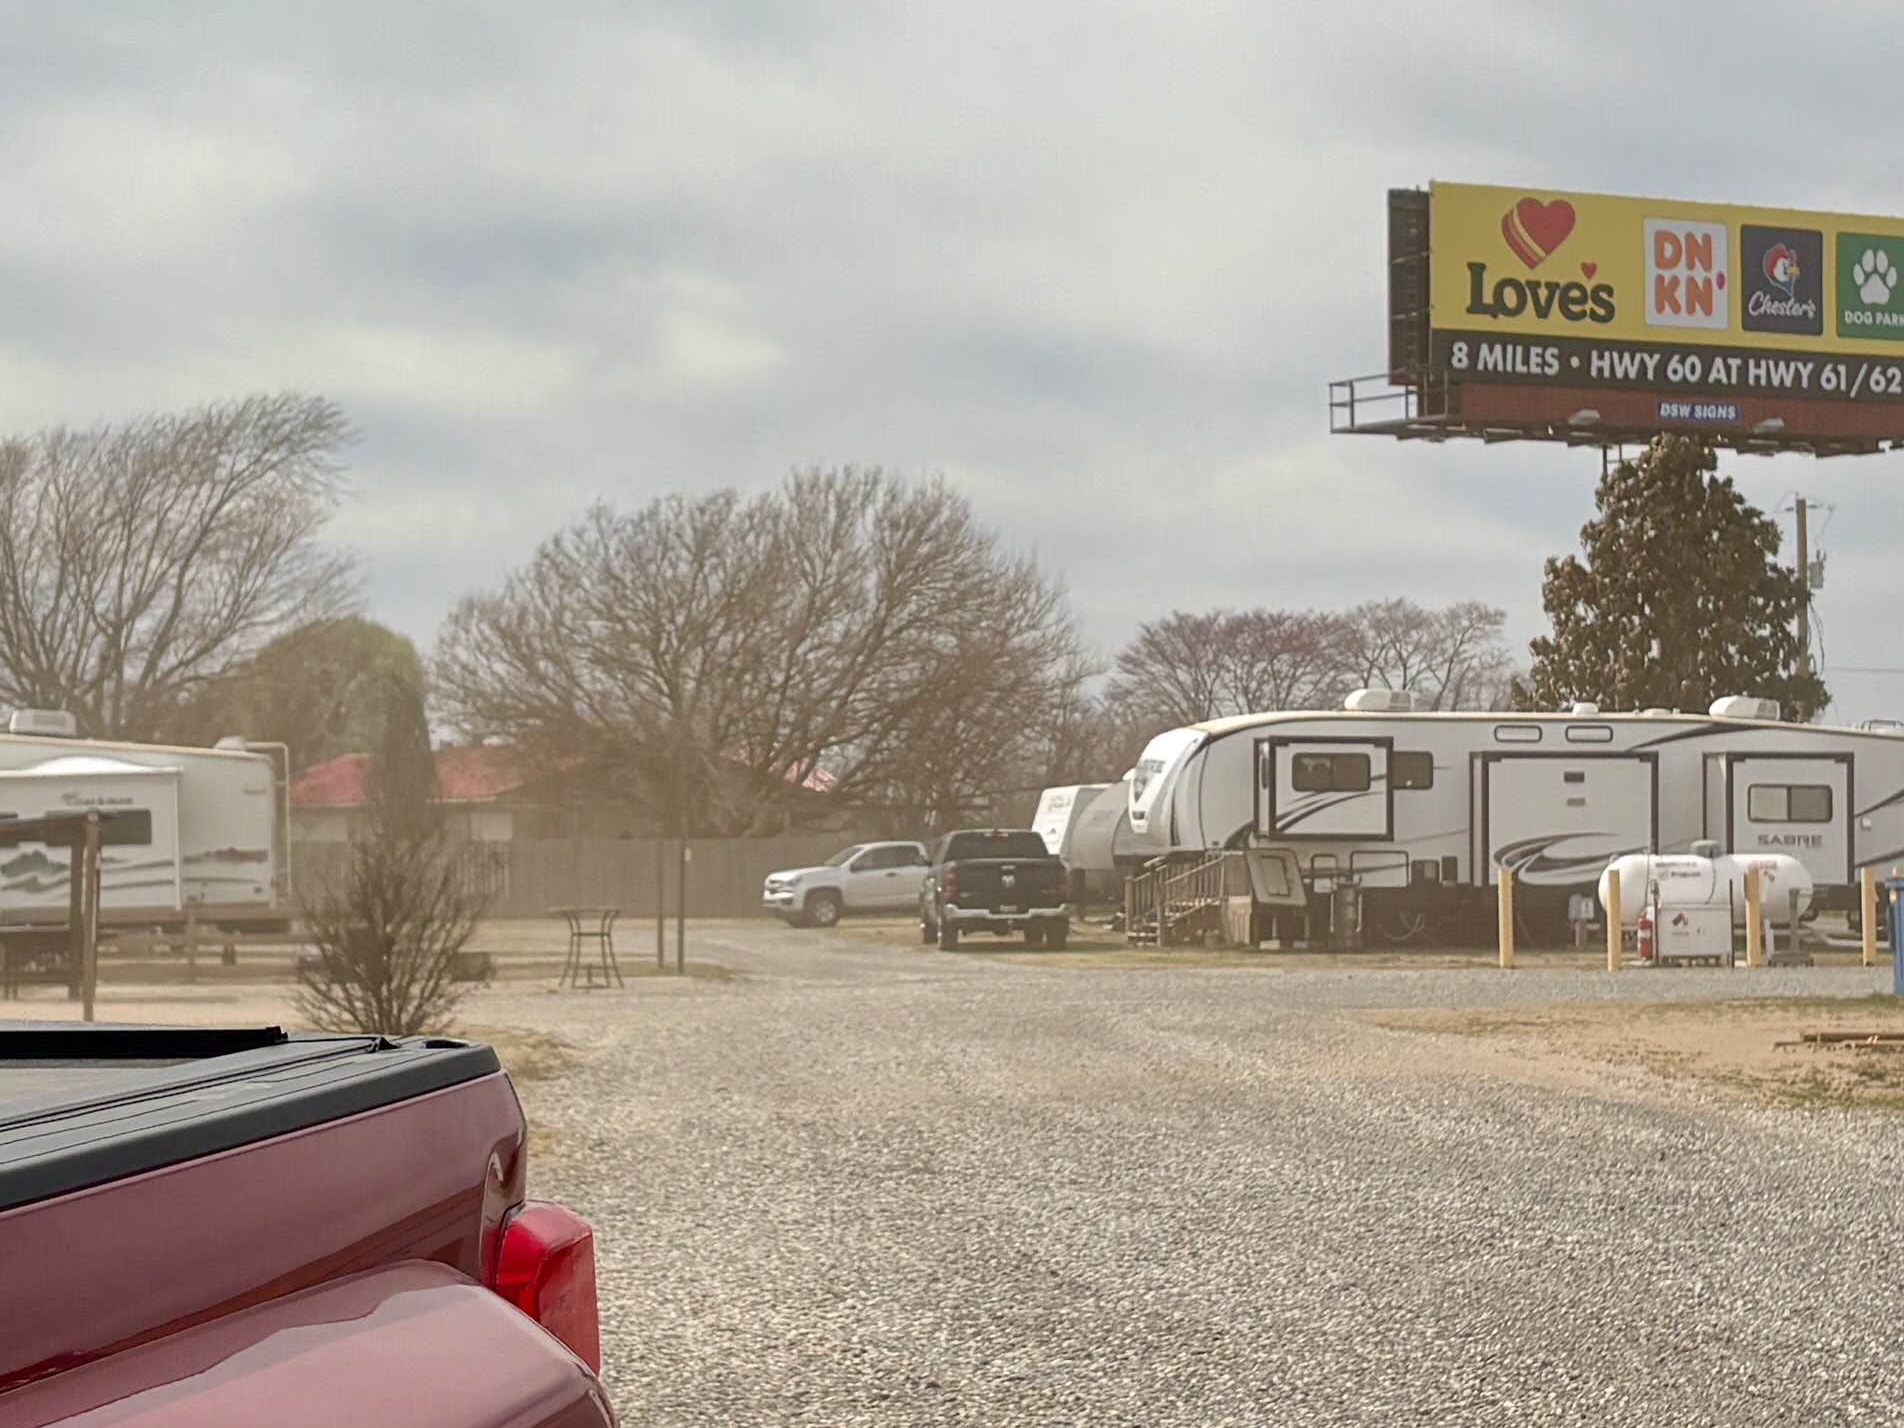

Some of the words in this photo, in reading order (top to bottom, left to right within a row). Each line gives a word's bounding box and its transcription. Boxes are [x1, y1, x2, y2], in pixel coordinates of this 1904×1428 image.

[1654, 230, 1712, 272] DN
[1844, 310, 1873, 324] DOG
[1451, 341, 1469, 369] 8
[1477, 343, 1560, 376] MILES
[1590, 350, 1661, 381] HWY
[1666, 354, 1702, 383] 60
[1707, 357, 1741, 385] AT
[1748, 359, 1814, 389] HWY
[1819, 363, 1902, 399] 61/62
[1659, 403, 1690, 419] DSW
[1694, 404, 1737, 421] SIGNS
